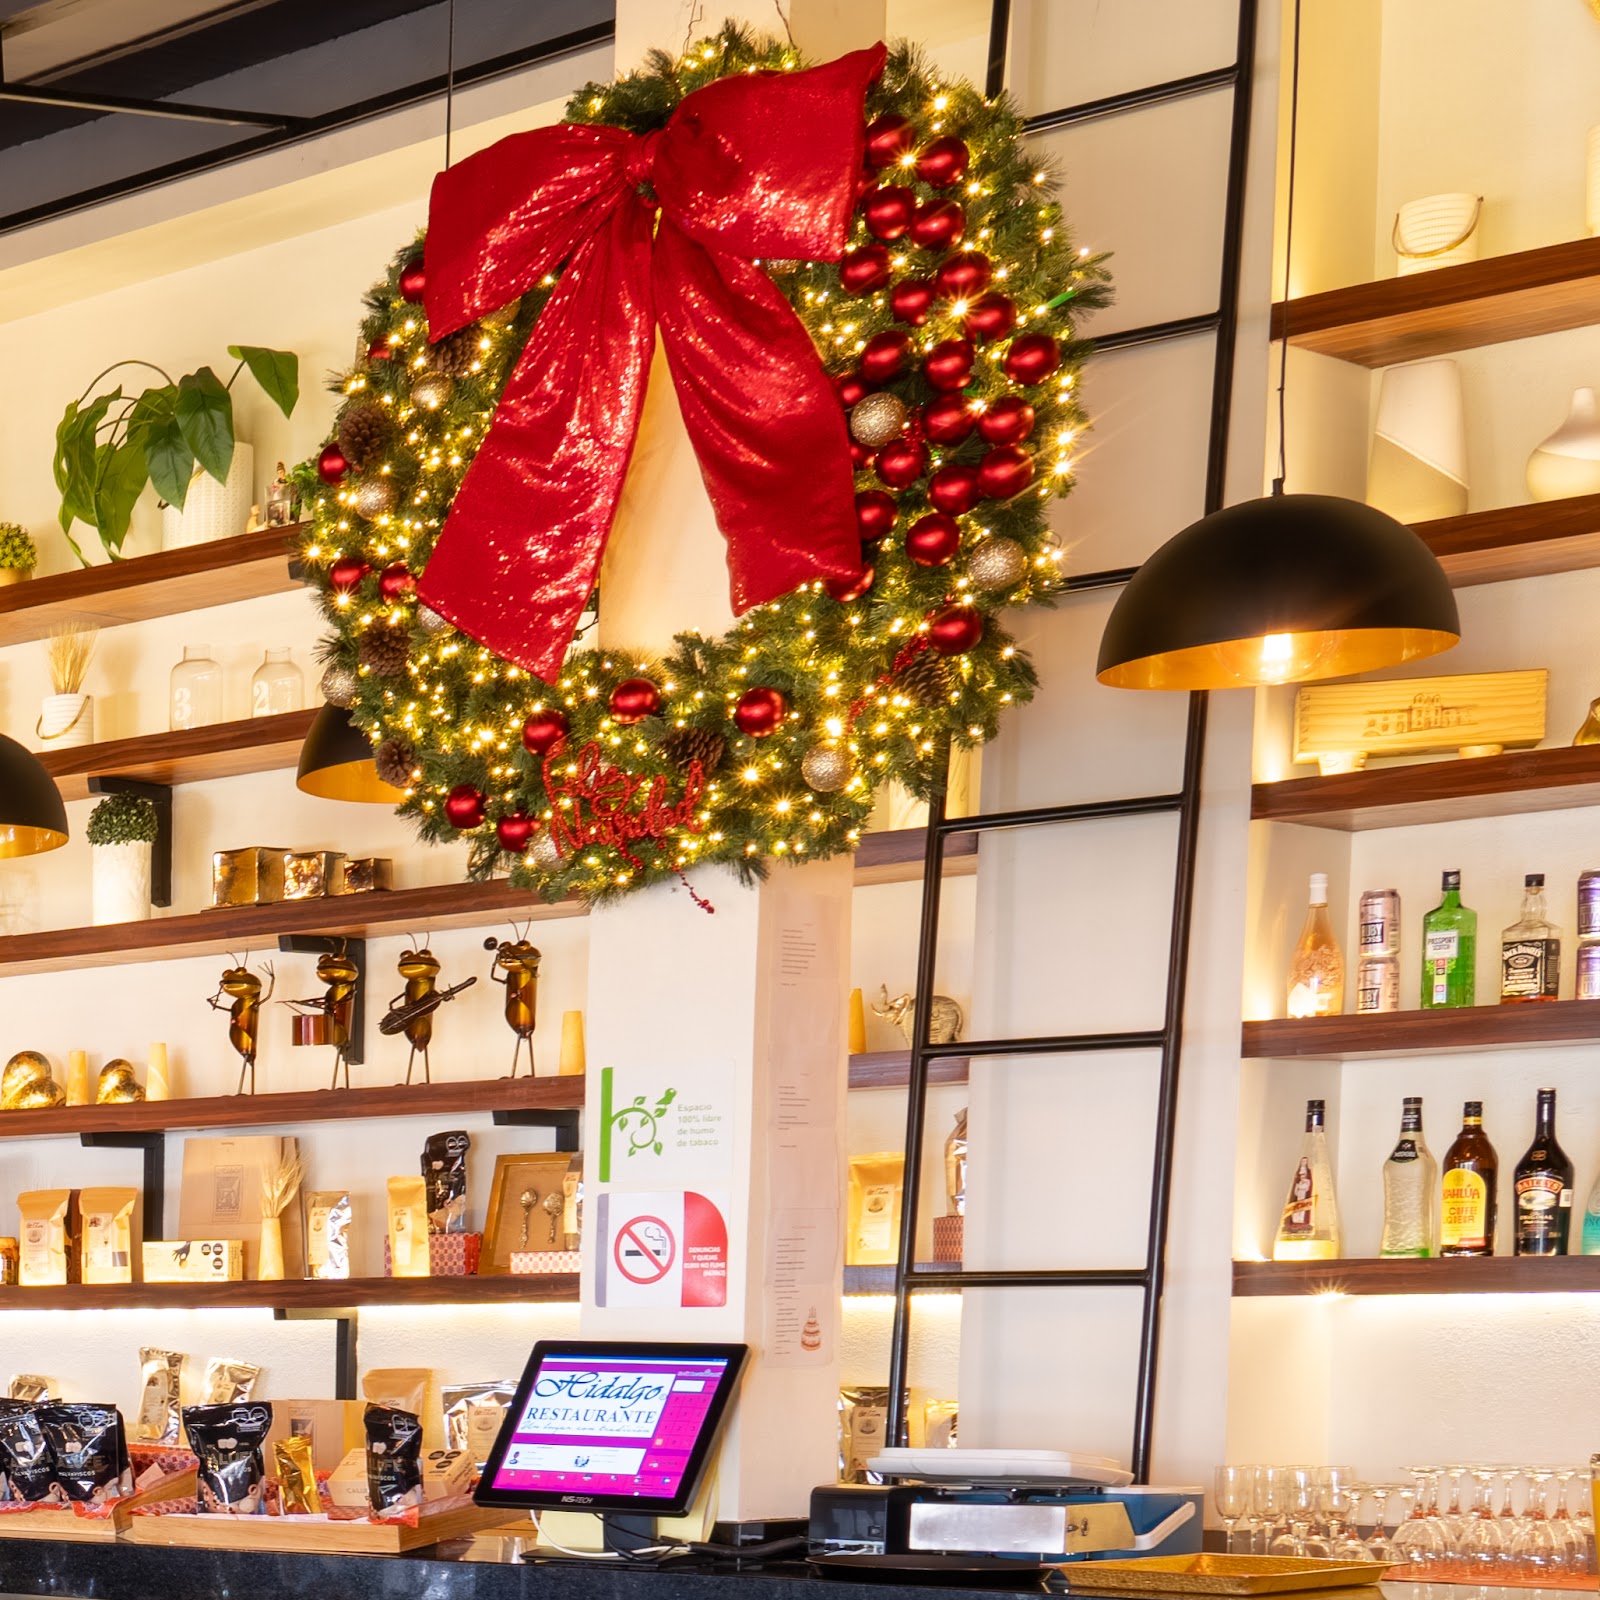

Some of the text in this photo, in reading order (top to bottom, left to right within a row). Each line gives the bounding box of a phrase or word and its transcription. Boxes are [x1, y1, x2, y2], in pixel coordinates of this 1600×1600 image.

[174, 687, 192, 722] 3
[253, 680, 273, 717] 2
[542, 739, 642, 818] Feliz
[551, 759, 705, 858] Navidad
[1428, 937, 1456, 945] PASSPORT
[1503, 948, 1518, 960] JACK
[678, 1104, 712, 1112] Espacio
[678, 1115, 700, 1123] 100%
[1517, 1180, 1561, 1192] BAILEYS
[1449, 1206, 1478, 1215] COFFEE
[534, 1372, 665, 1409] Hidalgo
[527, 1407, 657, 1424] RESTAURANTE
